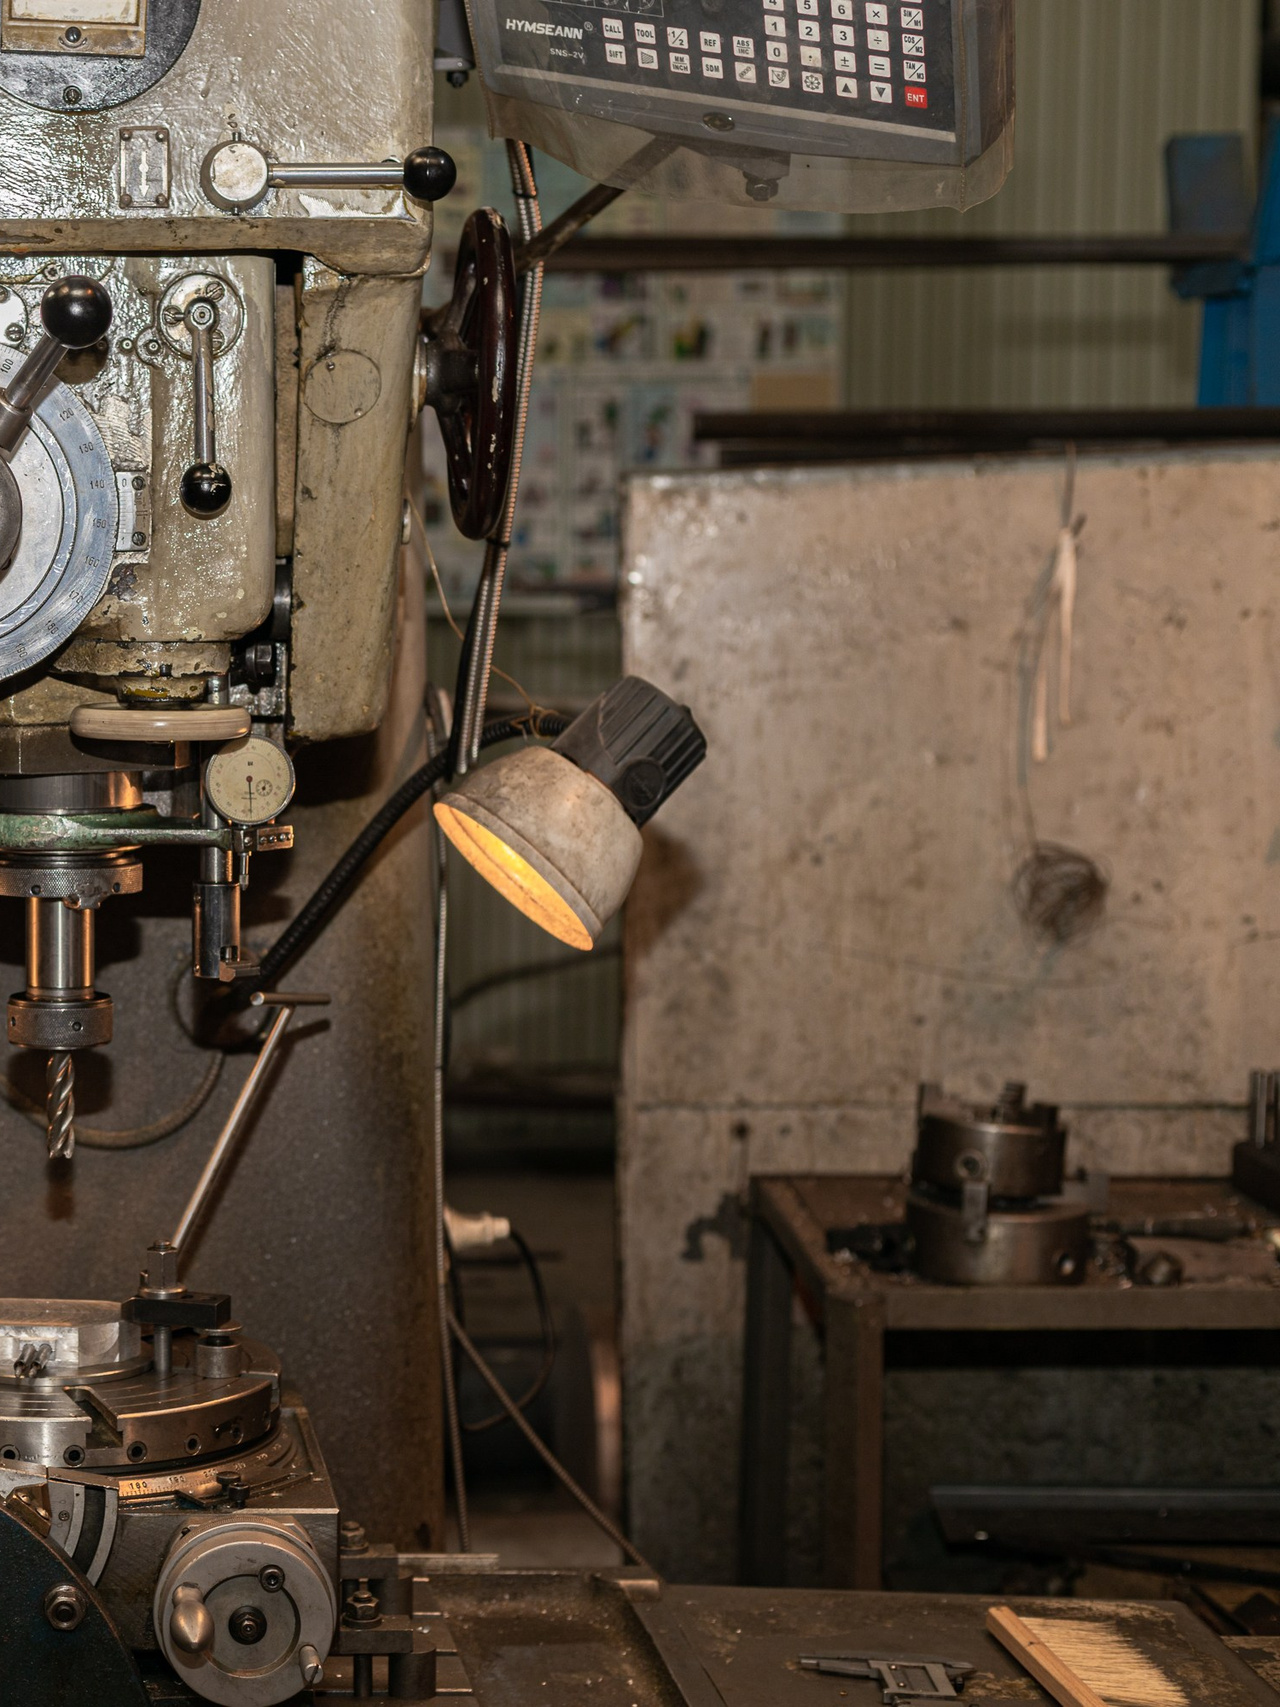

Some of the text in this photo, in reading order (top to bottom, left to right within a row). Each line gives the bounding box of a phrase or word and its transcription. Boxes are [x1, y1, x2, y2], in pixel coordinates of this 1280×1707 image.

[803, 0, 811, 10] 5
[838, 5, 846, 15] 6
[505, 18, 584, 39] HYMSEANN
[604, 24, 622, 34] CALL
[771, 21, 778, 32] 1
[805, 26, 813, 36] 2
[636, 28, 654, 39] TOOL
[839, 30, 847, 41] 3
[703, 38, 717, 47] REF
[736, 39, 750, 47] ABS
[903, 36, 915, 44] COS
[737, 47, 750, 55] INC
[773, 47, 781, 58] 0
[672, 63, 689, 72] INCH
[705, 63, 720, 73] SDM
[905, 61, 916, 70] TAN
[907, 94, 925, 103] ENT
[0, 358, 14, 373] 100
[59, 407, 75, 422] 120
[78, 442, 94, 454] 130
[89, 479, 105, 490] 140
[92, 517, 107, 529] 150
[84, 555, 100, 568] 160
[68, 589, 84, 605] 170
[45, 619, 59, 635] 180
[129, 1480, 148, 1490] 180
